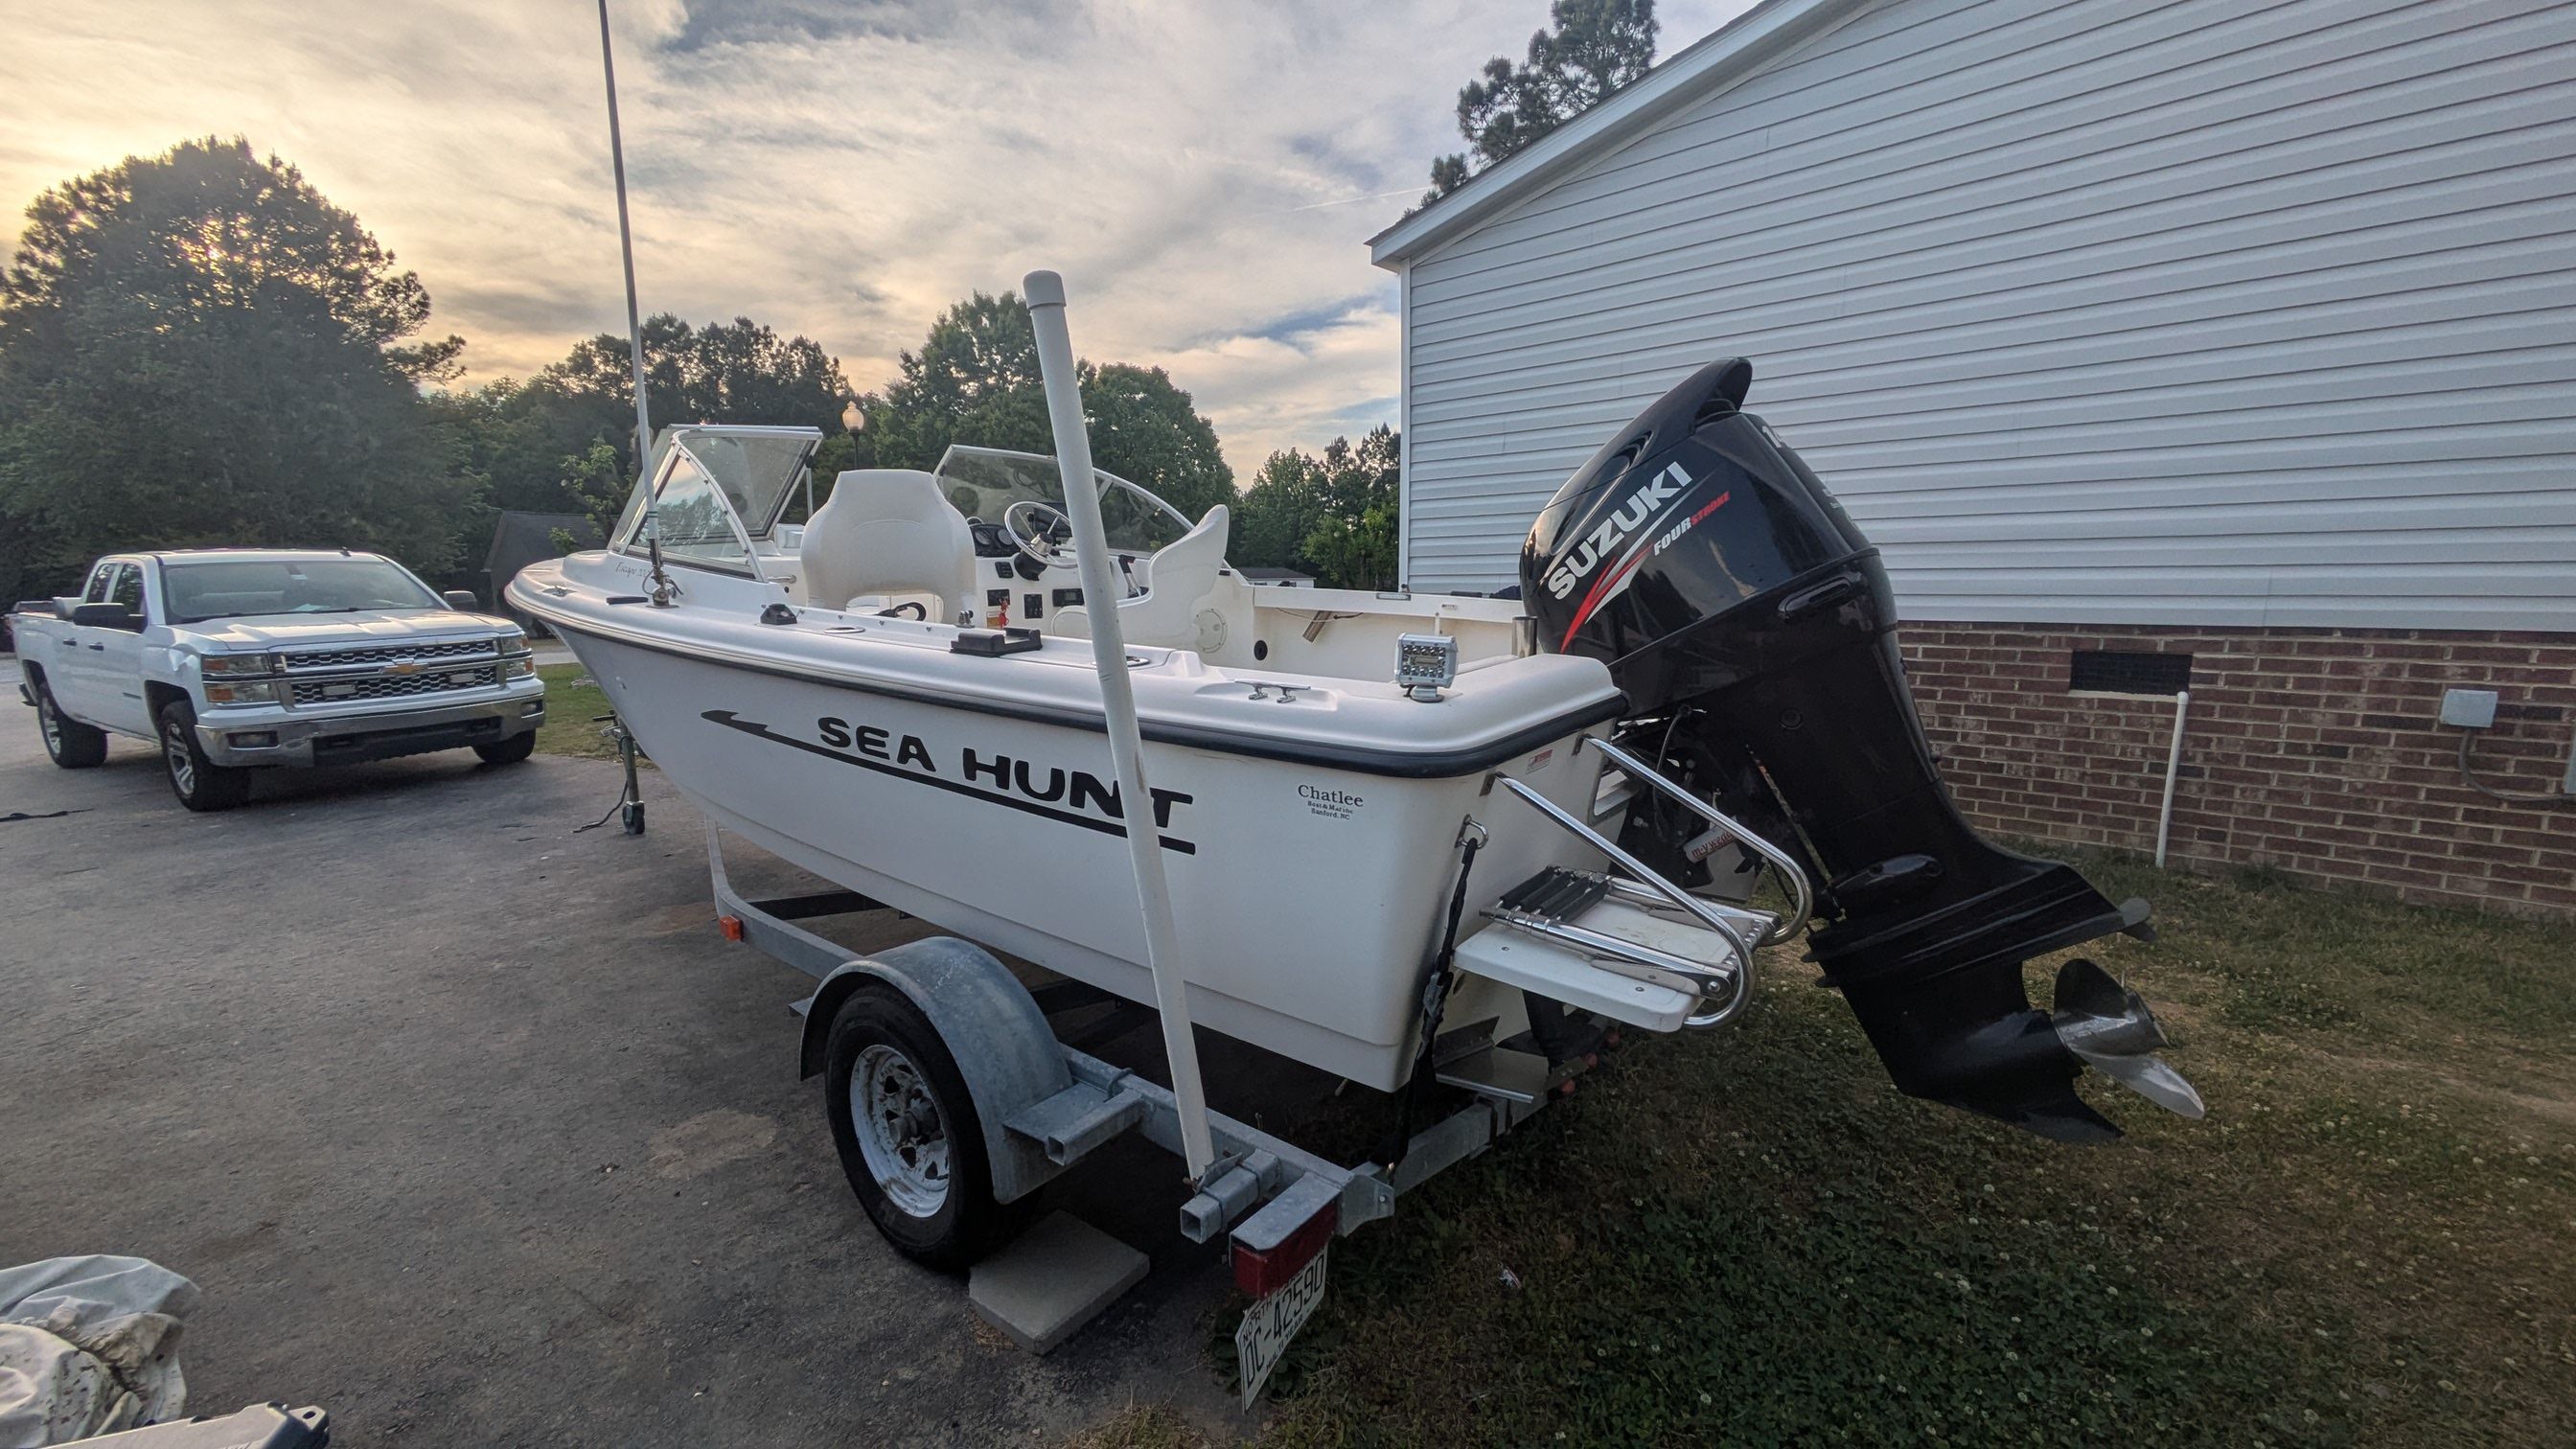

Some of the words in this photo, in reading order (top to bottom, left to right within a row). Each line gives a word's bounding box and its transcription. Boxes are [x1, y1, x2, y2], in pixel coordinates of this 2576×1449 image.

[1548, 461, 1693, 601] SUZUKI
[817, 716, 936, 772] SEA
[962, 748, 1193, 828] HUNT
[1298, 784, 1364, 807] Chatlee
